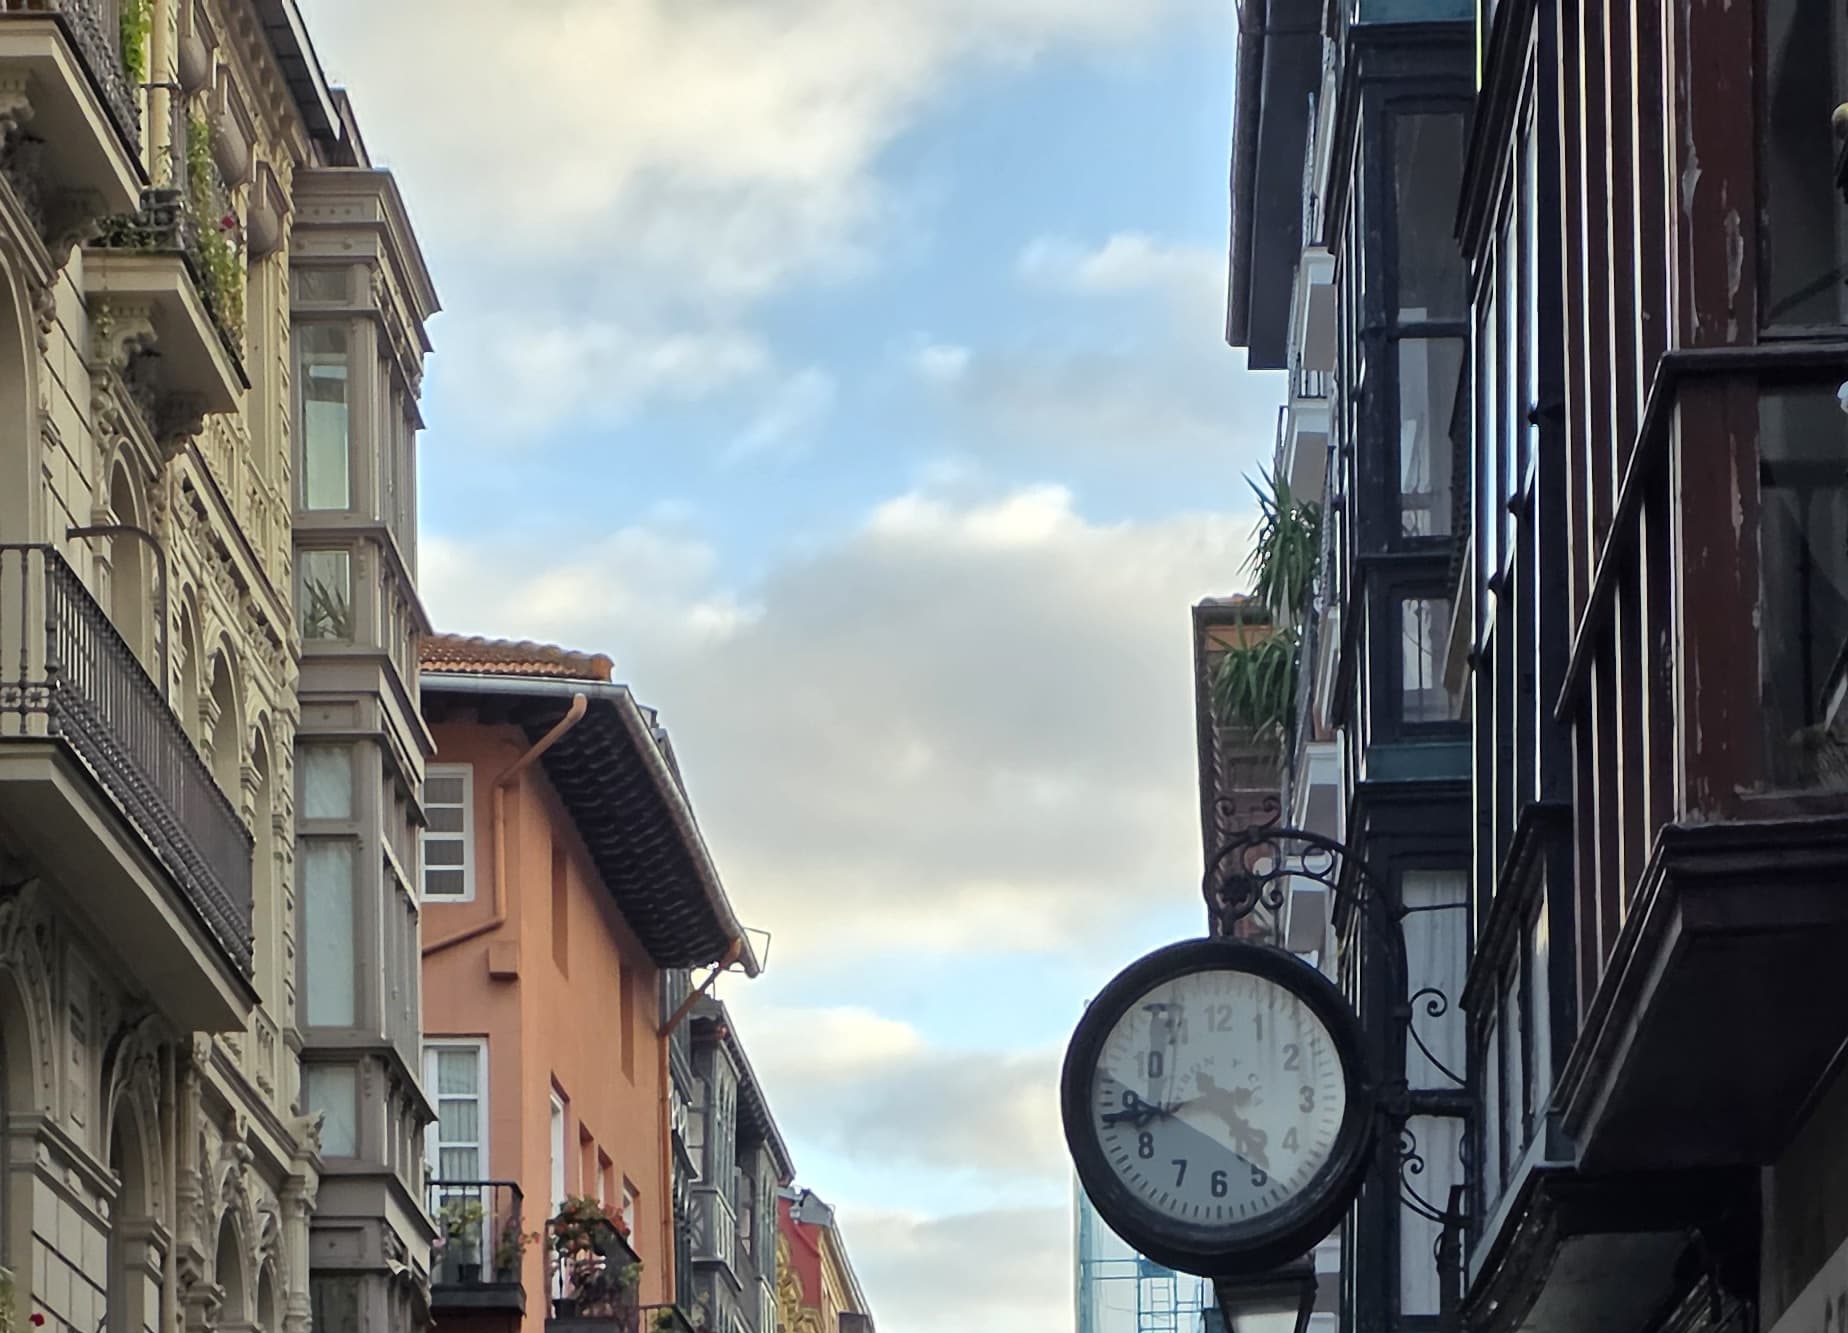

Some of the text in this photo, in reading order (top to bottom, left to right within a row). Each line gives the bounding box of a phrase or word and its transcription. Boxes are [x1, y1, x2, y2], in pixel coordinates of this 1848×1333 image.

[1204, 1004, 1233, 1032] 12
[1252, 1013, 1263, 1041] 1
[1136, 1050, 1164, 1078] 10
[1283, 1044, 1300, 1072] 2
[1299, 1086, 1315, 1113] 3
[1138, 1131, 1155, 1159] 8
[1282, 1127, 1299, 1154] 4
[1171, 1159, 1188, 1188] 7
[1211, 1170, 1229, 1198] 6
